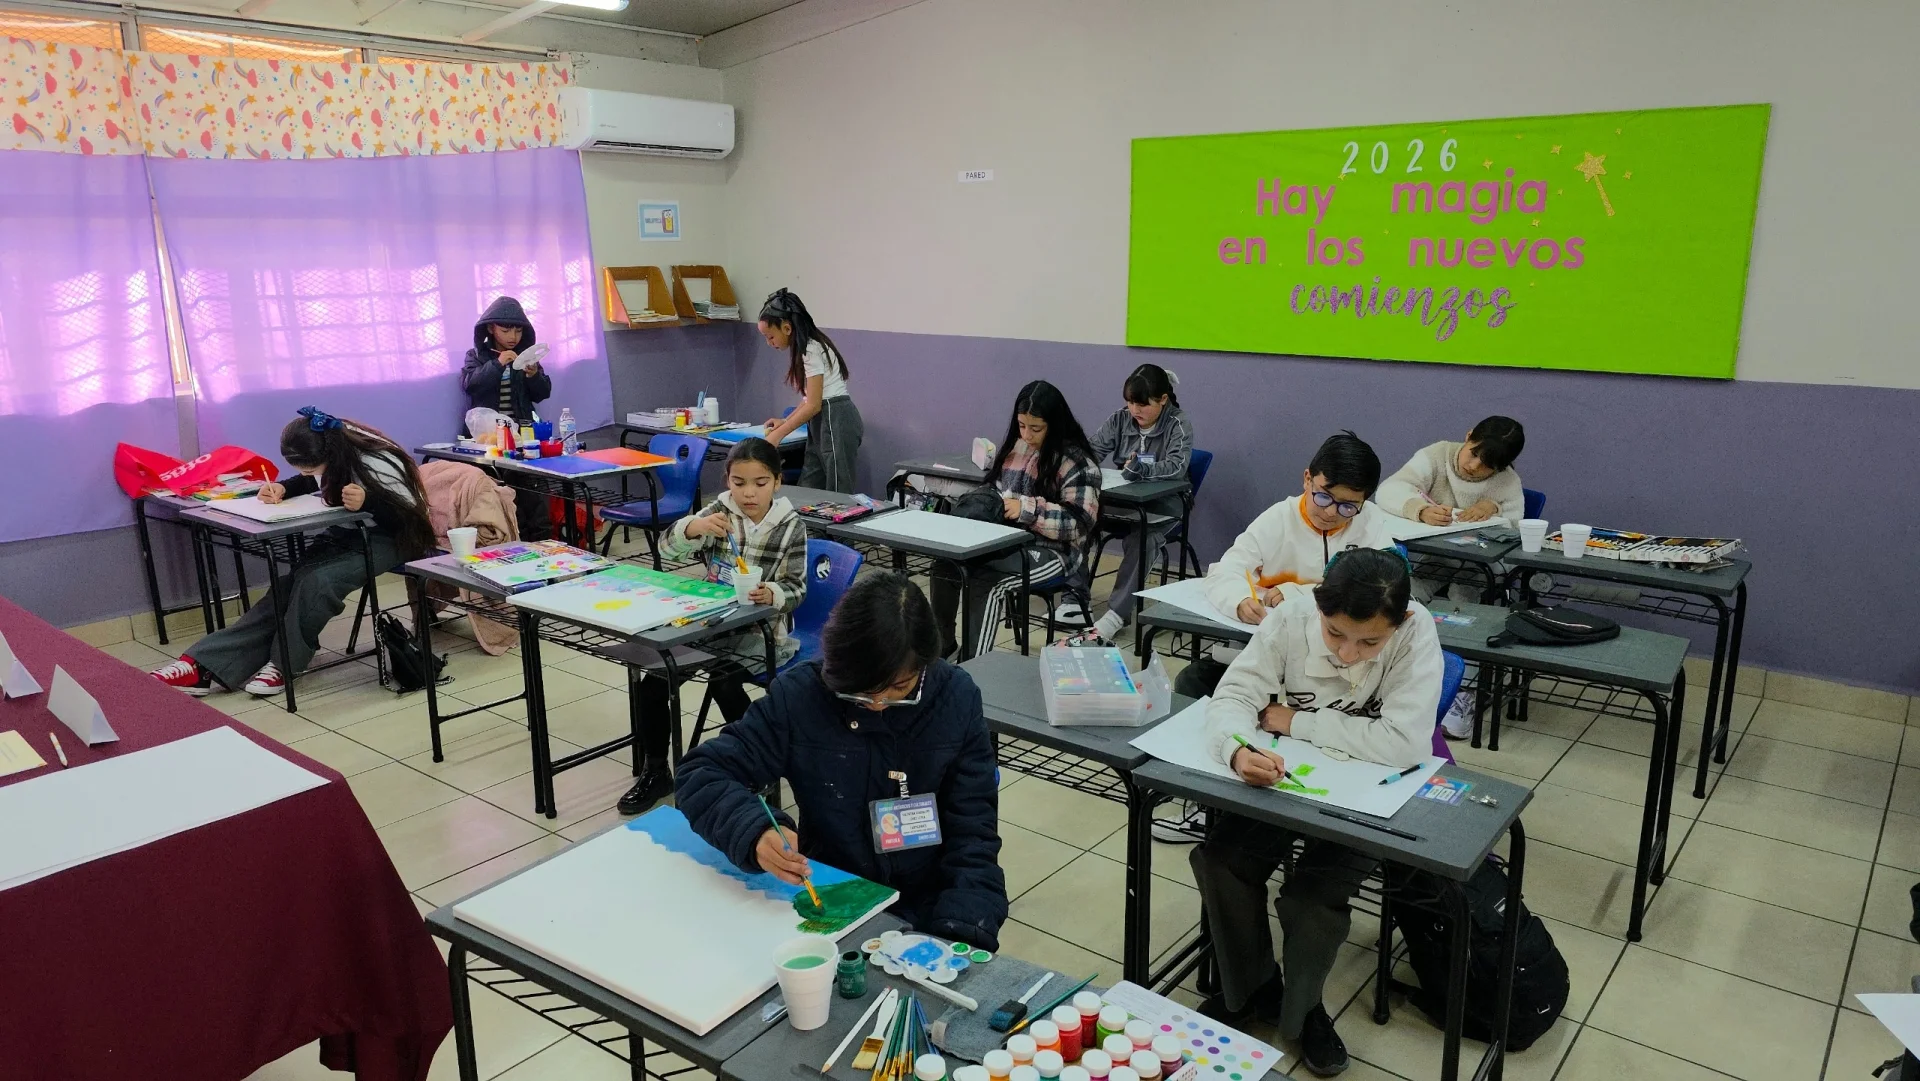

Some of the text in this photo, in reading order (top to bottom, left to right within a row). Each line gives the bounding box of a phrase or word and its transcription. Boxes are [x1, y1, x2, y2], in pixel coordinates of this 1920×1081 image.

[965, 171, 986, 180] PARED
[1341, 138, 1458, 174] 2026
[1257, 168, 1547, 225] Hay magia
[1218, 228, 1585, 270] en los nuevos
[1290, 276, 1517, 342] comienzos
